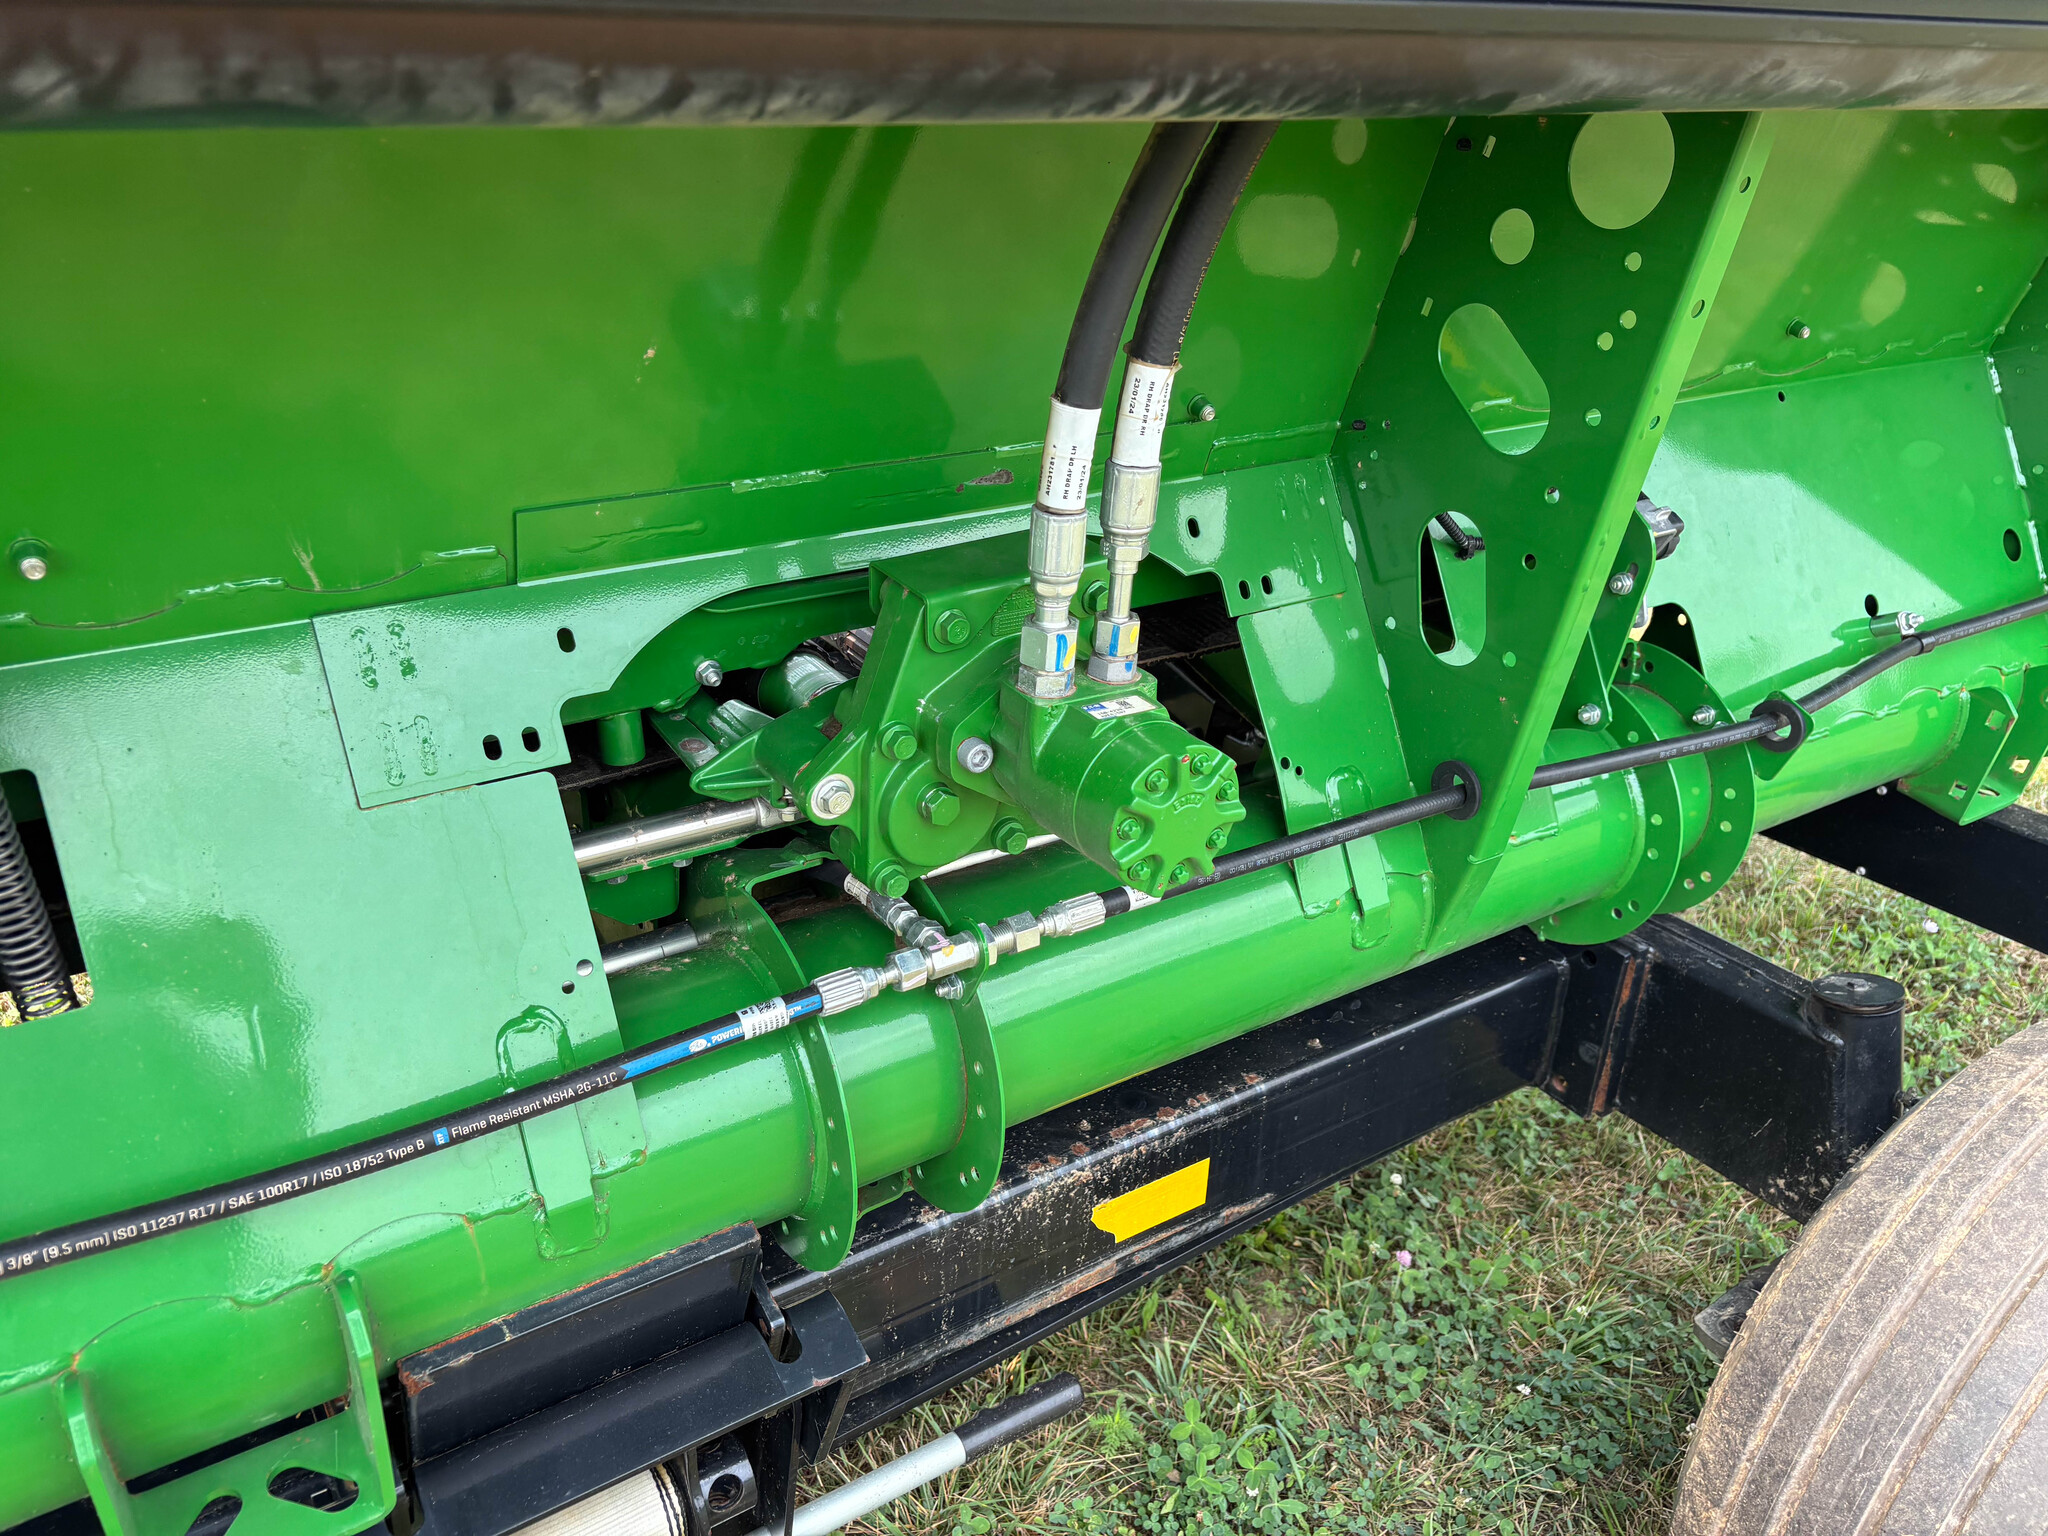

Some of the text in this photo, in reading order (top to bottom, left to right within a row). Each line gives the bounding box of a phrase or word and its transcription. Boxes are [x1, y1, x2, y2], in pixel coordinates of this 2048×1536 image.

[1128, 377, 1141, 415] 23/01/24
[1140, 381, 1155, 436] RH DRAP DR RH
[1045, 456, 1056, 496] AH231781
[1063, 488, 1069, 500] RH
[1071, 445, 1078, 456] LH
[1077, 464, 1087, 500] 23/01/24
[451, 1071, 618, 1138] Flame Resistant MSHA 2G-11C
[113, 1224, 138, 1242] ISO
[140, 1211, 186, 1235] 11237
[188, 1203, 216, 1221] R17
[219, 1201, 226, 1214] /
[228, 1192, 256, 1210] SAE
[257, 1176, 309, 1201] 100R17
[312, 1173, 317, 1186] /
[320, 1166, 342, 1182] ISO
[345, 1152, 385, 1174] 18752
[386, 1142, 415, 1160] Type
[416, 1139, 425, 1151] B
